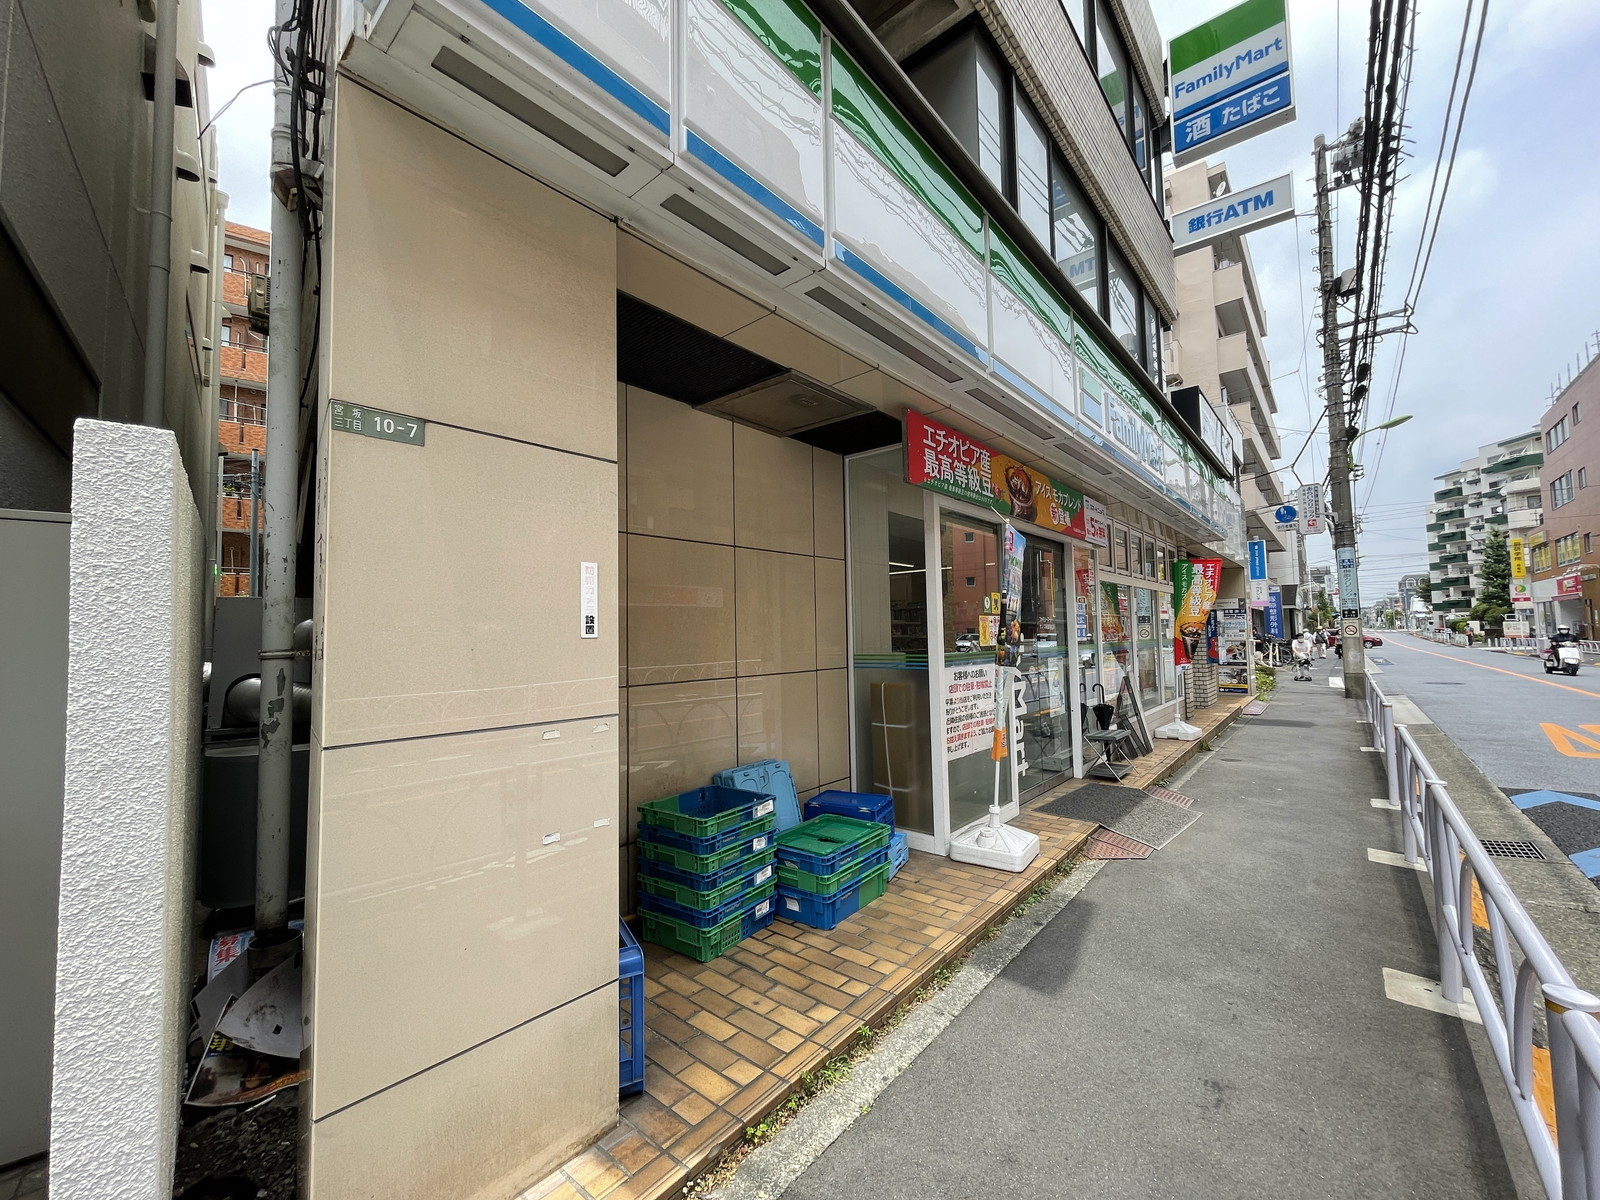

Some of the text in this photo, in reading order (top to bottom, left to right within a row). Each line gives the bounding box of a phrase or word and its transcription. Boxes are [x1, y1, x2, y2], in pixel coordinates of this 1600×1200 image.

[1174, 37, 1283, 99] FamilyMart
[1185, 85, 1281, 144] 酒 たばこ
[1188, 190, 1274, 234] 銀行ATM
[374, 416, 418, 438] 10-7
[922, 425, 992, 473] エチオピア産
[923, 448, 994, 498] 最高等級豆
[1189, 563, 1205, 617] 最高等級豆
[1201, 563, 1215, 610] エチオピア産
[953, 669, 988, 681] お客様へのお願い
